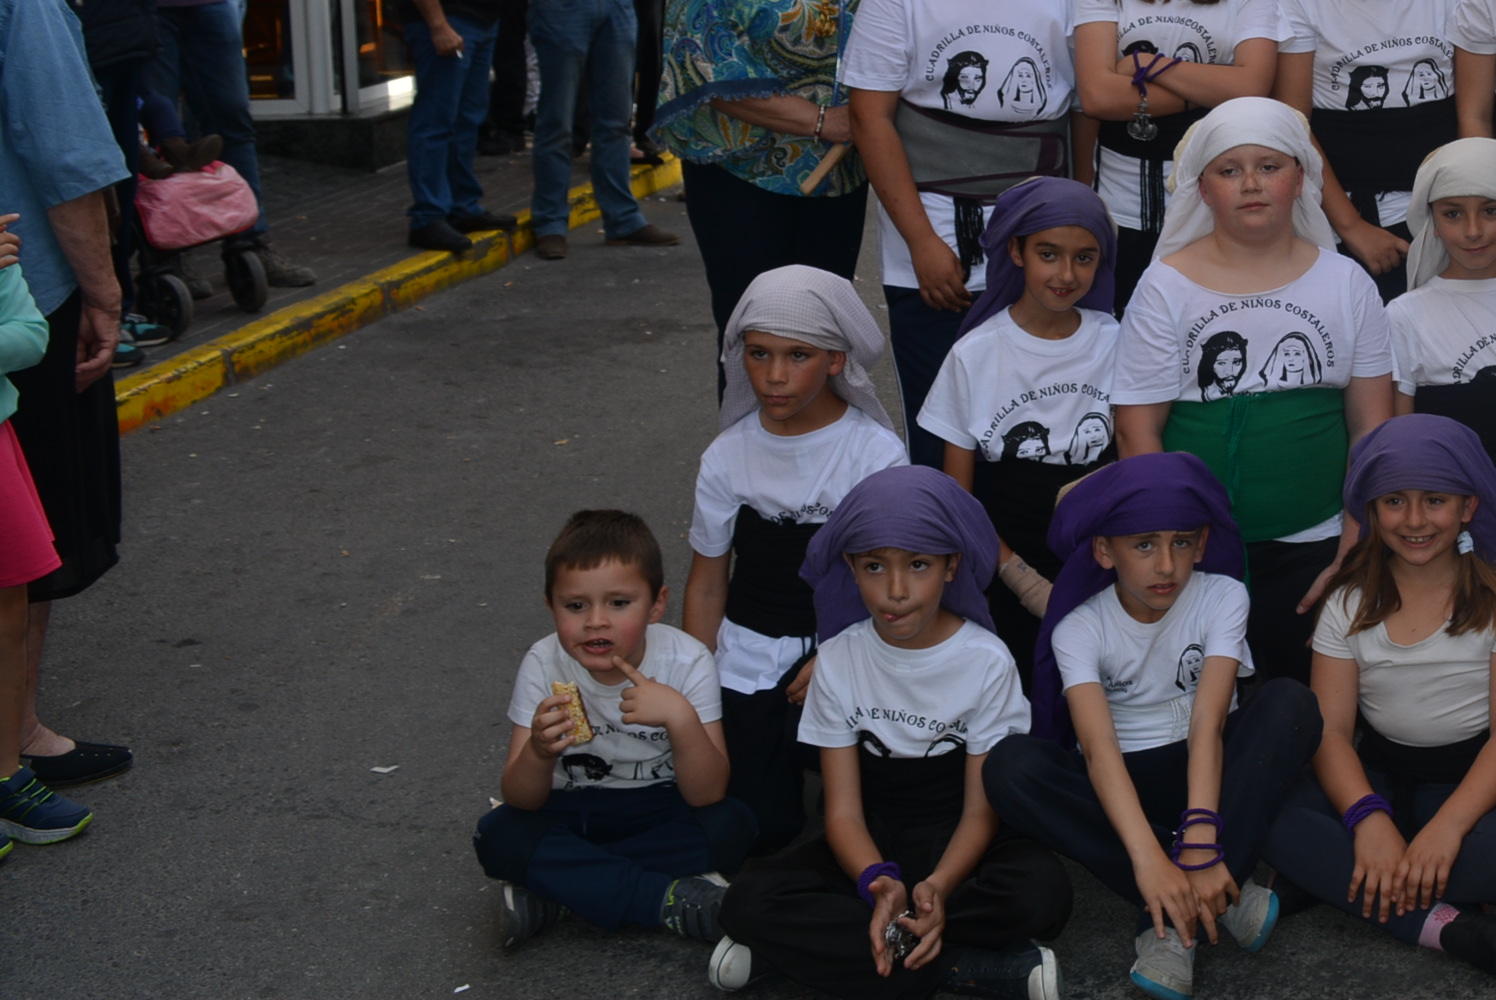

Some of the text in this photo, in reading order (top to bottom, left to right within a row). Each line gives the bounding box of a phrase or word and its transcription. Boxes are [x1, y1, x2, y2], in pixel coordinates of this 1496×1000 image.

[1138, 16, 1153, 26] DE
[925, 29, 966, 83] CUADRILLA
[966, 24, 982, 36] DE
[983, 23, 1016, 38] NIÑOS
[1364, 43, 1379, 55] DE
[1380, 37, 1413, 50] NIÑOS
[1219, 302, 1238, 315] DE
[1240, 296, 1282, 309] NIÑOS
[1285, 302, 1335, 368] COSTALEROS
[1475, 337, 1490, 349] DE
[1020, 390, 1037, 405] DE
[1038, 382, 1078, 399] NIÑOS
[882, 708, 926, 729] NIÑOS
